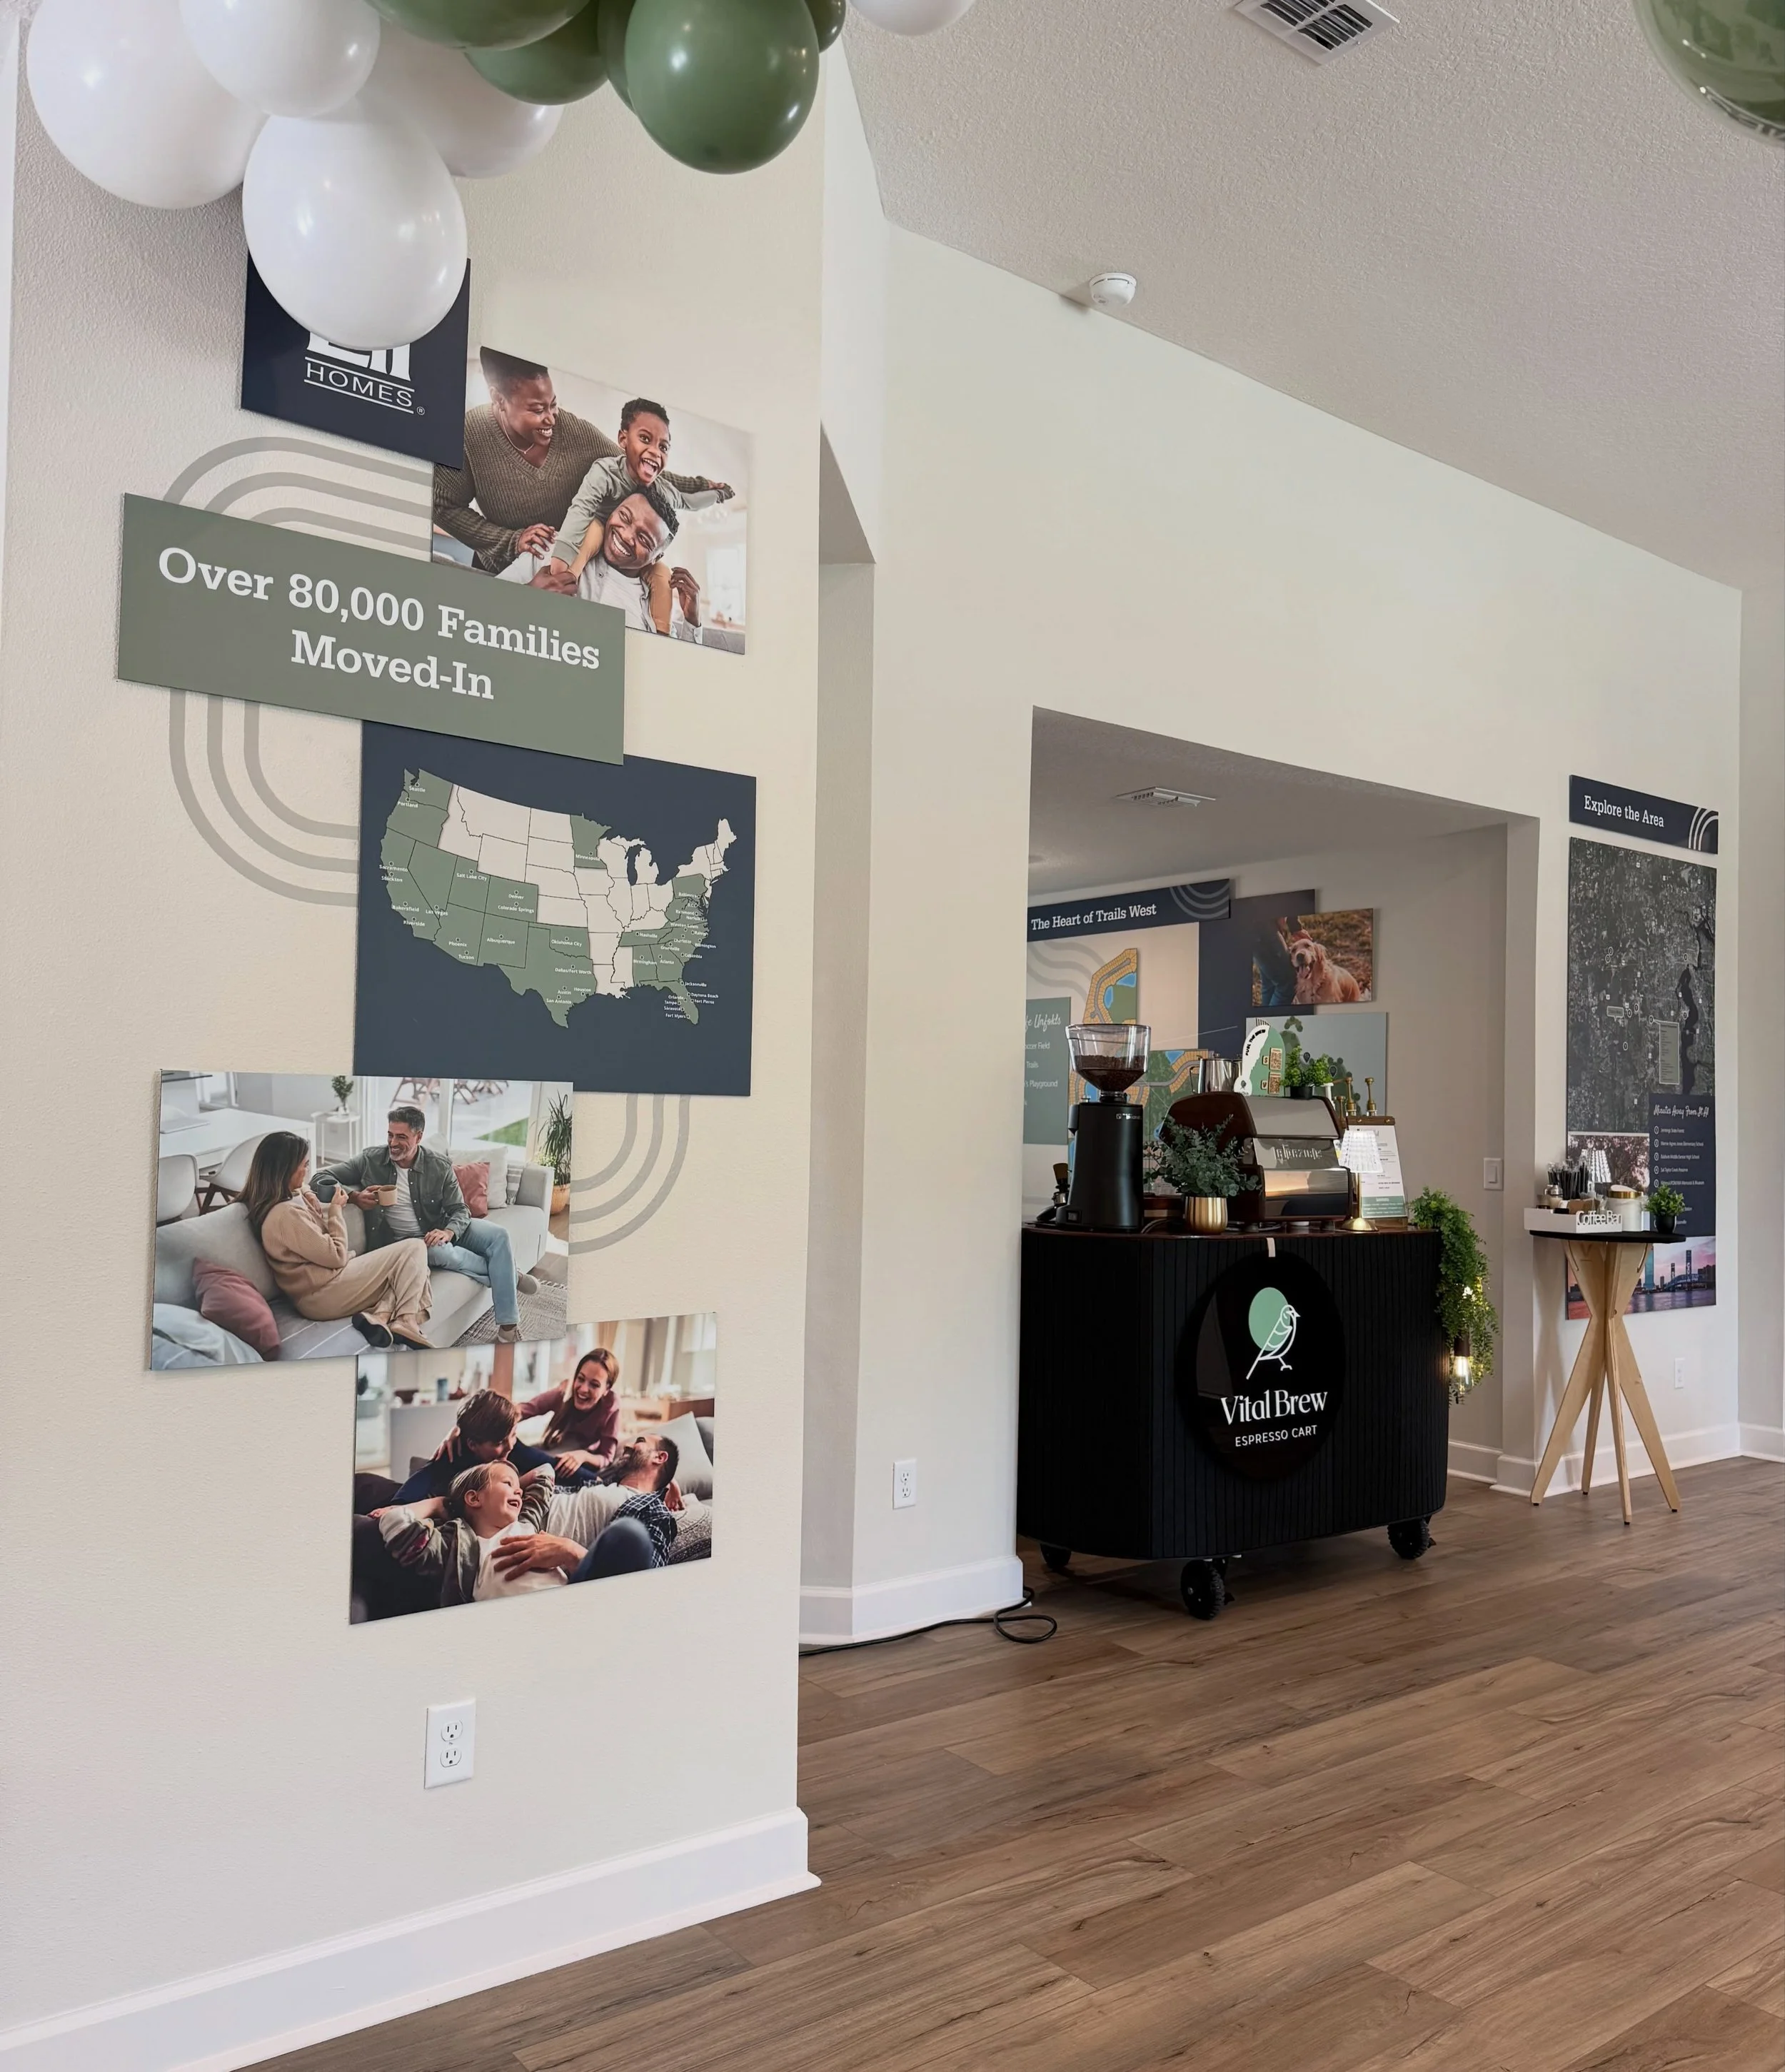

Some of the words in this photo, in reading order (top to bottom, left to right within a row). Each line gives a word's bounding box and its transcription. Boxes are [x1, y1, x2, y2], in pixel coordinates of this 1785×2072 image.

[306, 362, 413, 407] HOMES
[159, 547, 274, 600] Over
[288, 573, 424, 630] 80,000
[438, 605, 600, 670] Families
[291, 629, 494, 700] Moved-In
[1584, 795, 1621, 818] Explore
[1624, 805, 1639, 821] the
[1642, 810, 1664, 828] Area
[1031, 918, 1050, 930] The
[1052, 915, 1081, 928] Heart
[1083, 911, 1093, 924] of
[1096, 907, 1127, 922] Trails
[1129, 903, 1157, 917] West
[1034, 1014, 1061, 1032] Unfolds
[1030, 1080, 1058, 1089] Playground
[1576, 1210, 1606, 1225] Coffee
[1220, 1389, 1271, 1425] Vital
[1274, 1389, 1328, 1417] Brew
[1235, 1429, 1288, 1447] ESPRESSO
[1292, 1425, 1317, 1438] CART
